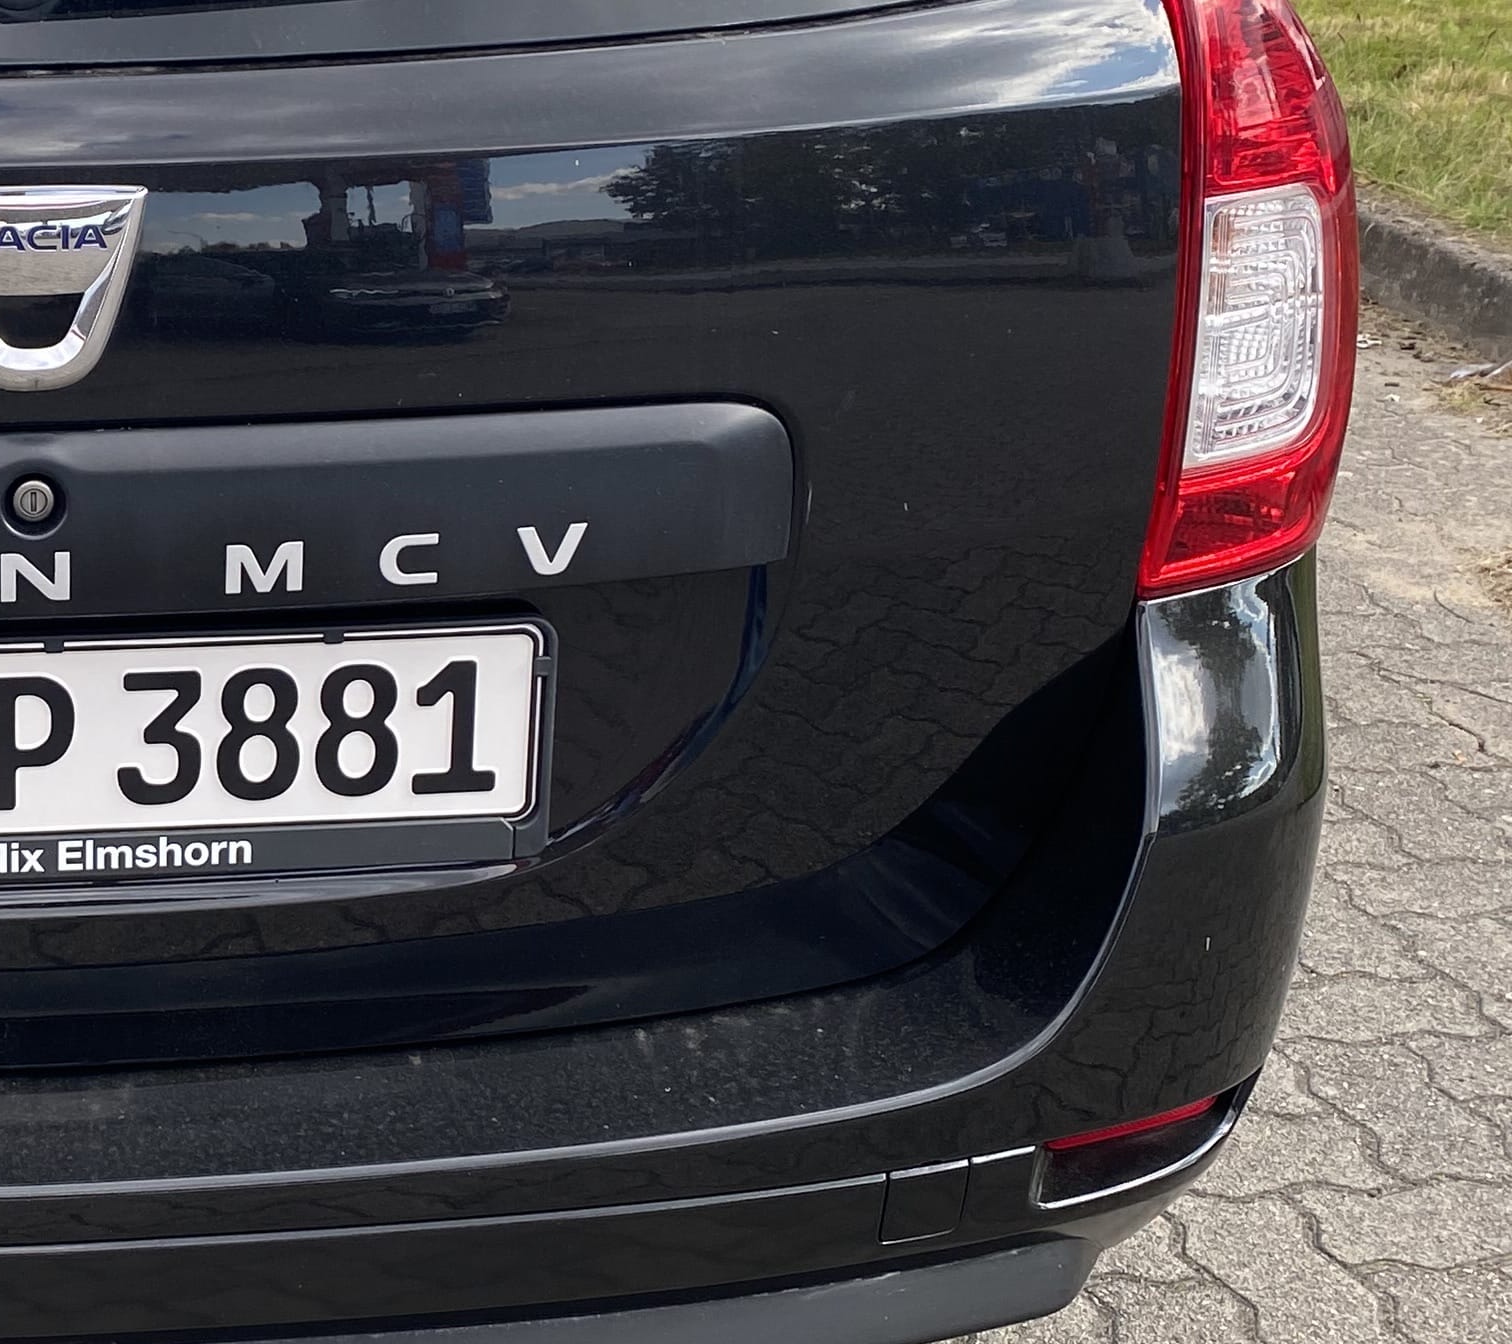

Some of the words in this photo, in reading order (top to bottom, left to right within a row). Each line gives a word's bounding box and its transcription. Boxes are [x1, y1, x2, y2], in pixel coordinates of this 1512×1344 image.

[225, 522, 588, 594] MCV
[116, 659, 497, 806] 3881
[57, 836, 254, 872] Elmshorn
